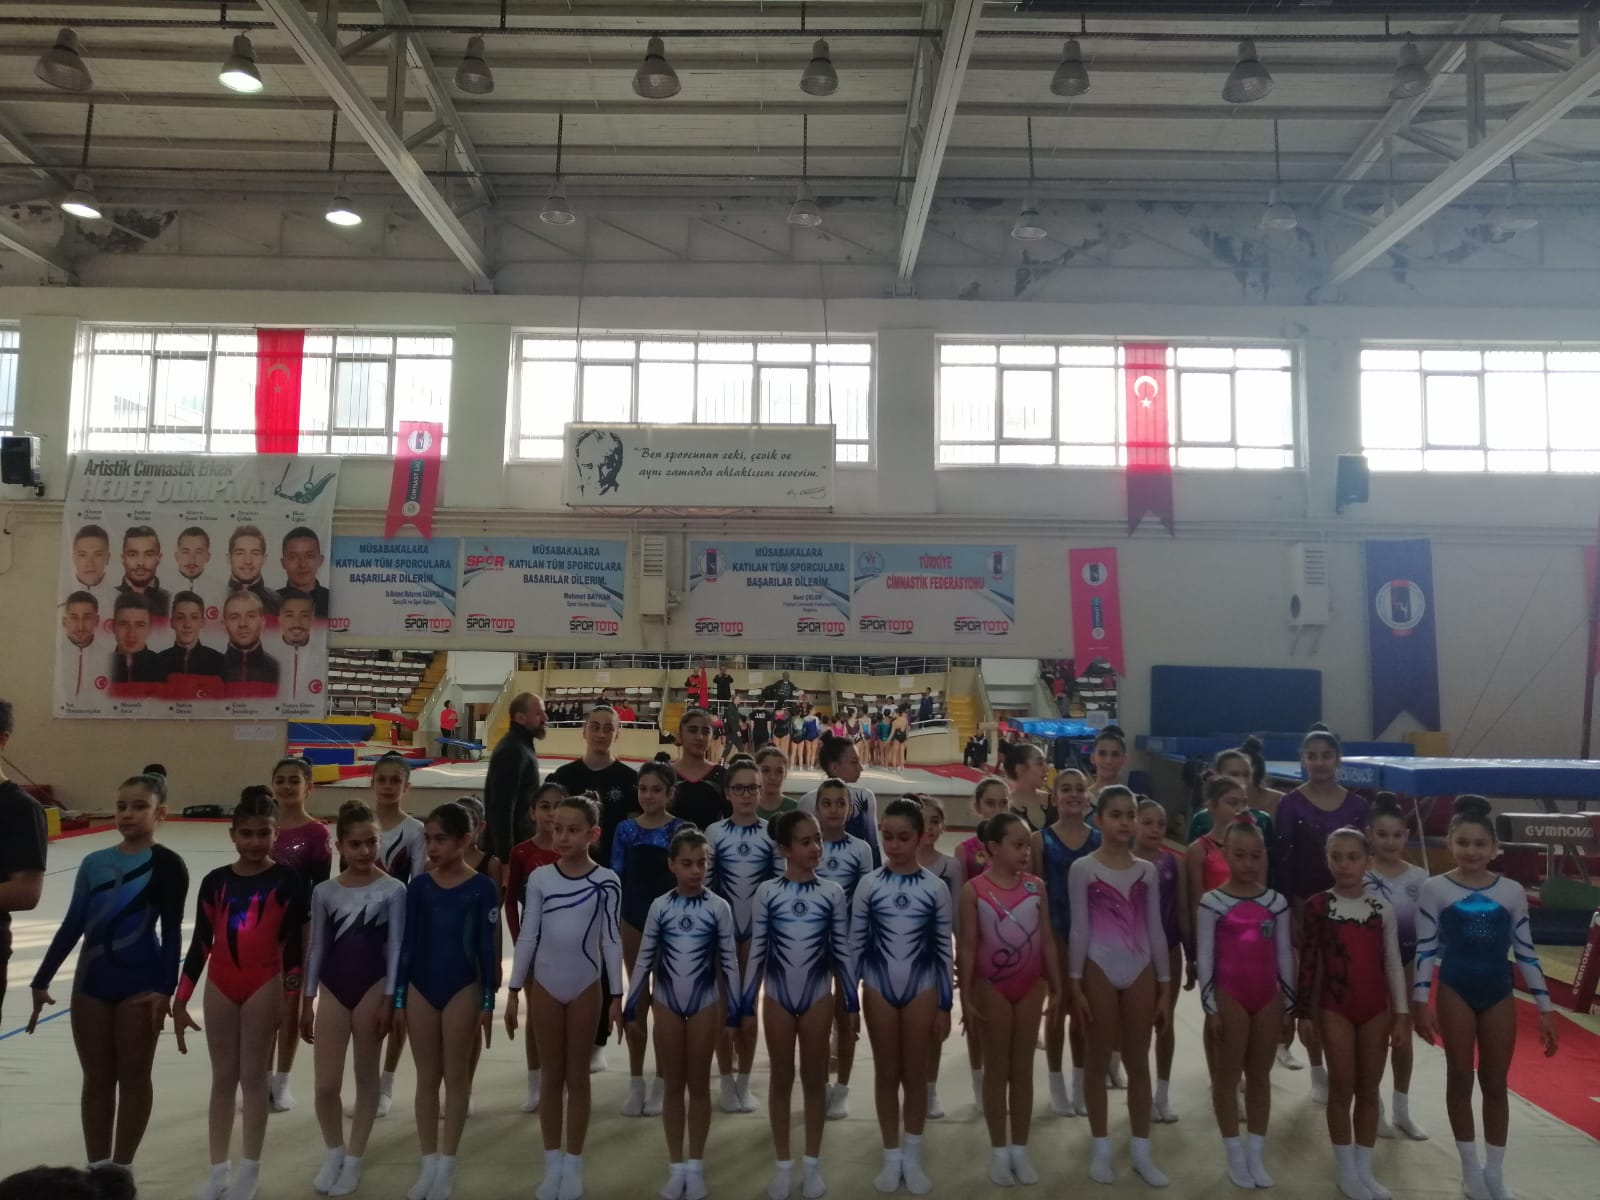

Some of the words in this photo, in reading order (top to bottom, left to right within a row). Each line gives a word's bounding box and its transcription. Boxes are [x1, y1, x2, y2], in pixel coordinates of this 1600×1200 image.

[664, 451, 718, 463] sporcunun
[780, 452, 792, 460] ve
[84, 459, 131, 477] Artistik
[133, 459, 195, 478] Cimnastik
[638, 468, 662, 480] aynı
[665, 466, 713, 478] zamanda
[80, 478, 152, 503] HEDEF
[360, 543, 428, 554] MÜSABAKALARA
[532, 543, 600, 556] MÜSABAKALARA
[755, 546, 823, 558] MÜSABAKALARA
[335, 559, 372, 569] KATILAN
[375, 557, 393, 569] TÜM
[395, 559, 451, 569] SPORCULARA
[466, 555, 505, 567] SPOR
[509, 560, 544, 570] KATILAN
[546, 559, 564, 570] TÜM
[567, 561, 622, 572] SPORCULARA
[732, 562, 768, 572] KATILAN
[771, 561, 788, 572] TÜM
[790, 562, 845, 572] SPORCULARA
[350, 573, 397, 584] BAŞARILAR
[746, 576, 793, 588] BAŞARILAR
[930, 576, 985, 590] FEDERASYONU
[328, 618, 350, 628] TOTO
[1525, 825, 1594, 839] GYMNOVA
